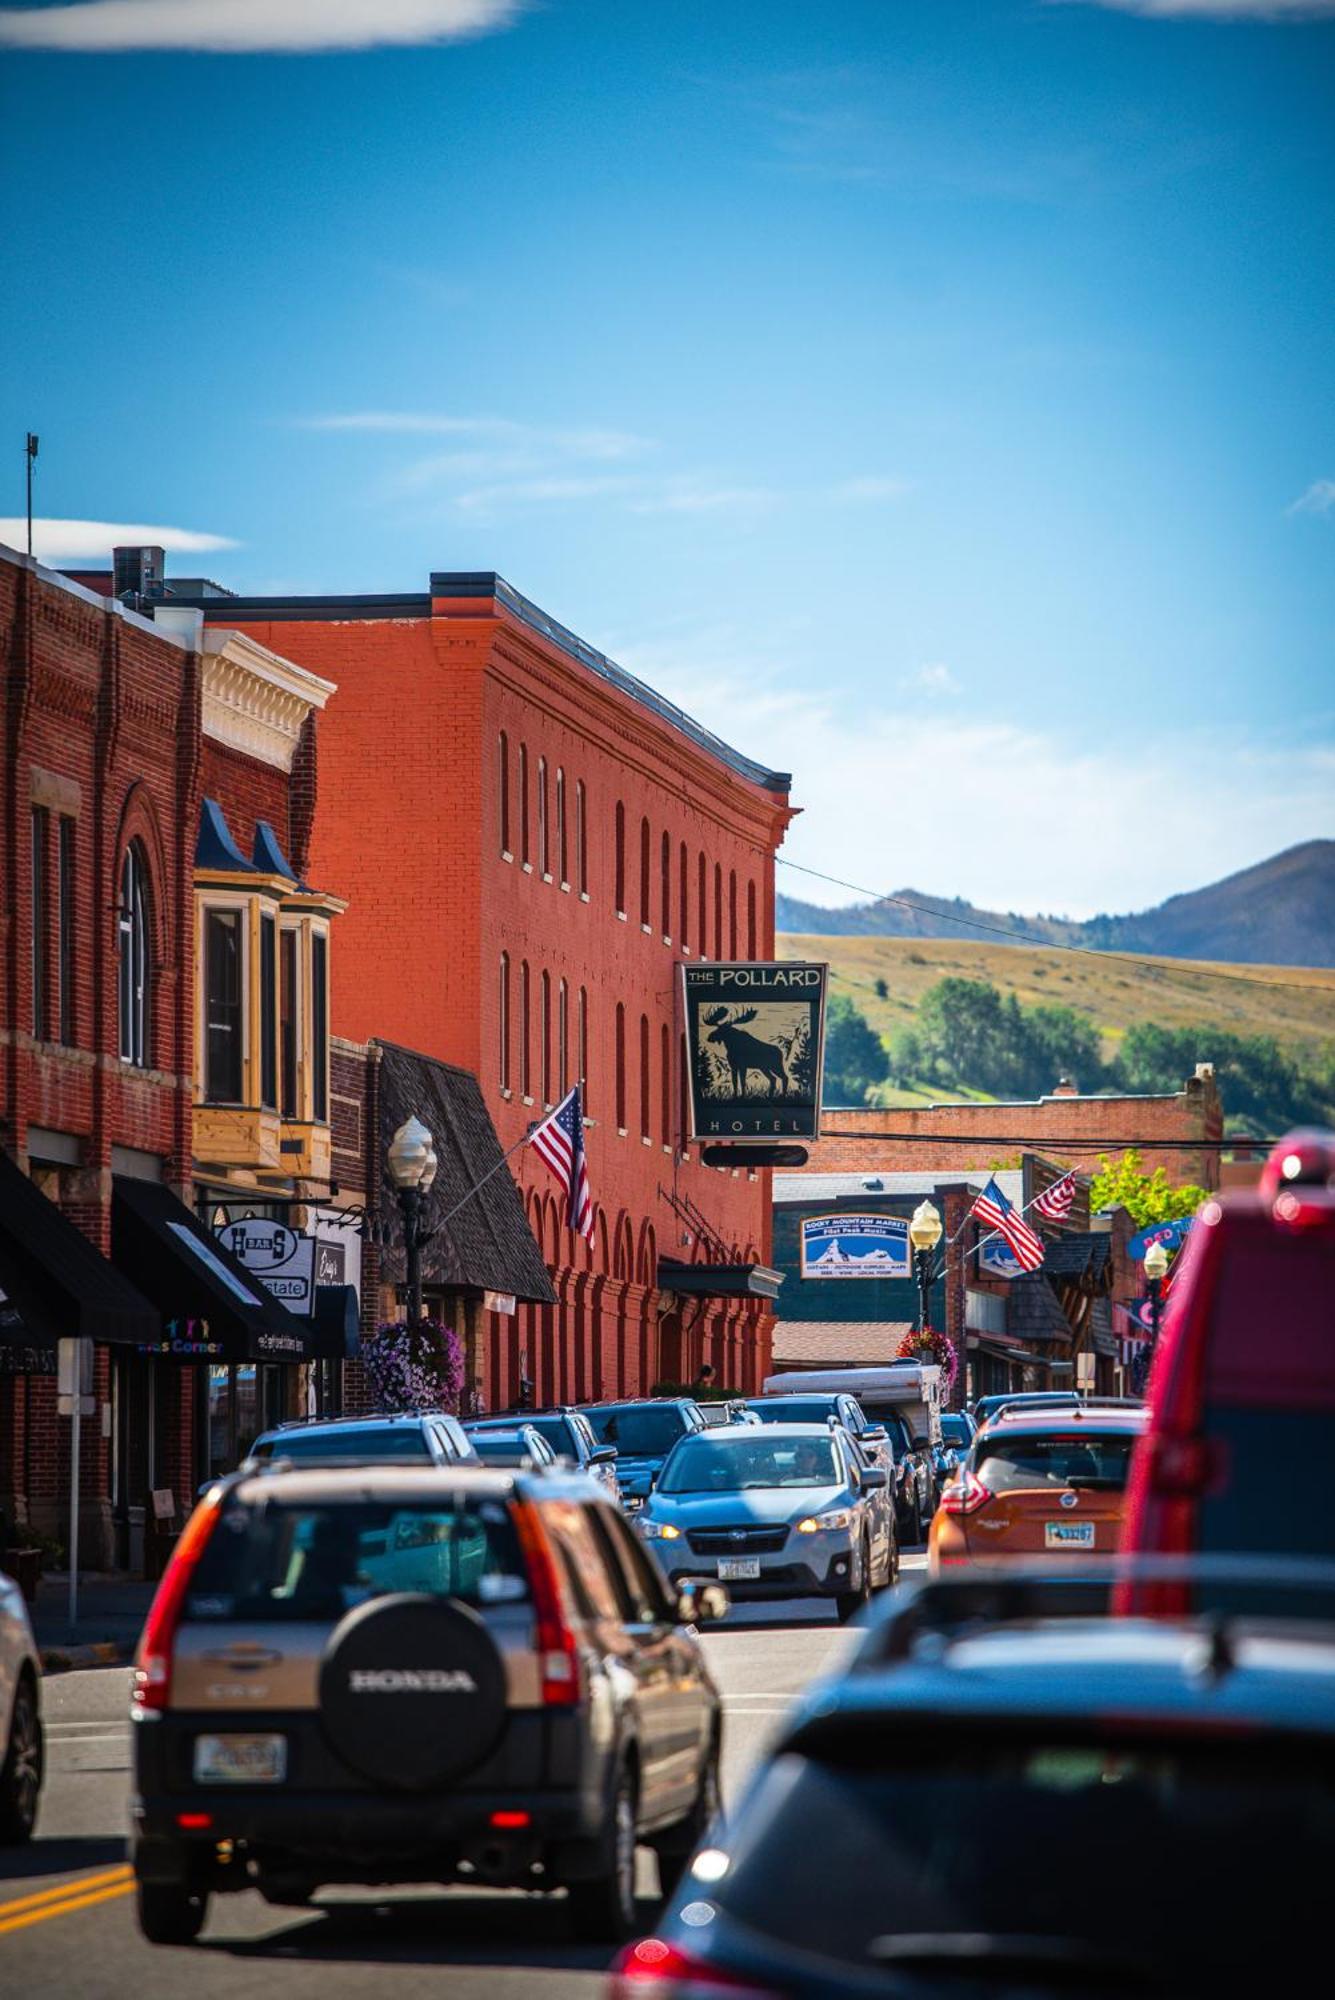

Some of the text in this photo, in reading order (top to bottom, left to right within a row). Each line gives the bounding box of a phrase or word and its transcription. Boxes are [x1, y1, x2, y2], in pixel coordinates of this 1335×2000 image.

[688, 970, 821, 987] THE POLLARD
[709, 1120, 800, 1132] HOTEL
[806, 1220, 829, 1229] ROCKY
[875, 1220, 906, 1229] MARKET
[231, 1227, 286, 1260] H BAR S
[265, 1281, 302, 1295] state
[172, 1339, 224, 1354] Corner
[350, 1670, 477, 1692] HONDA
